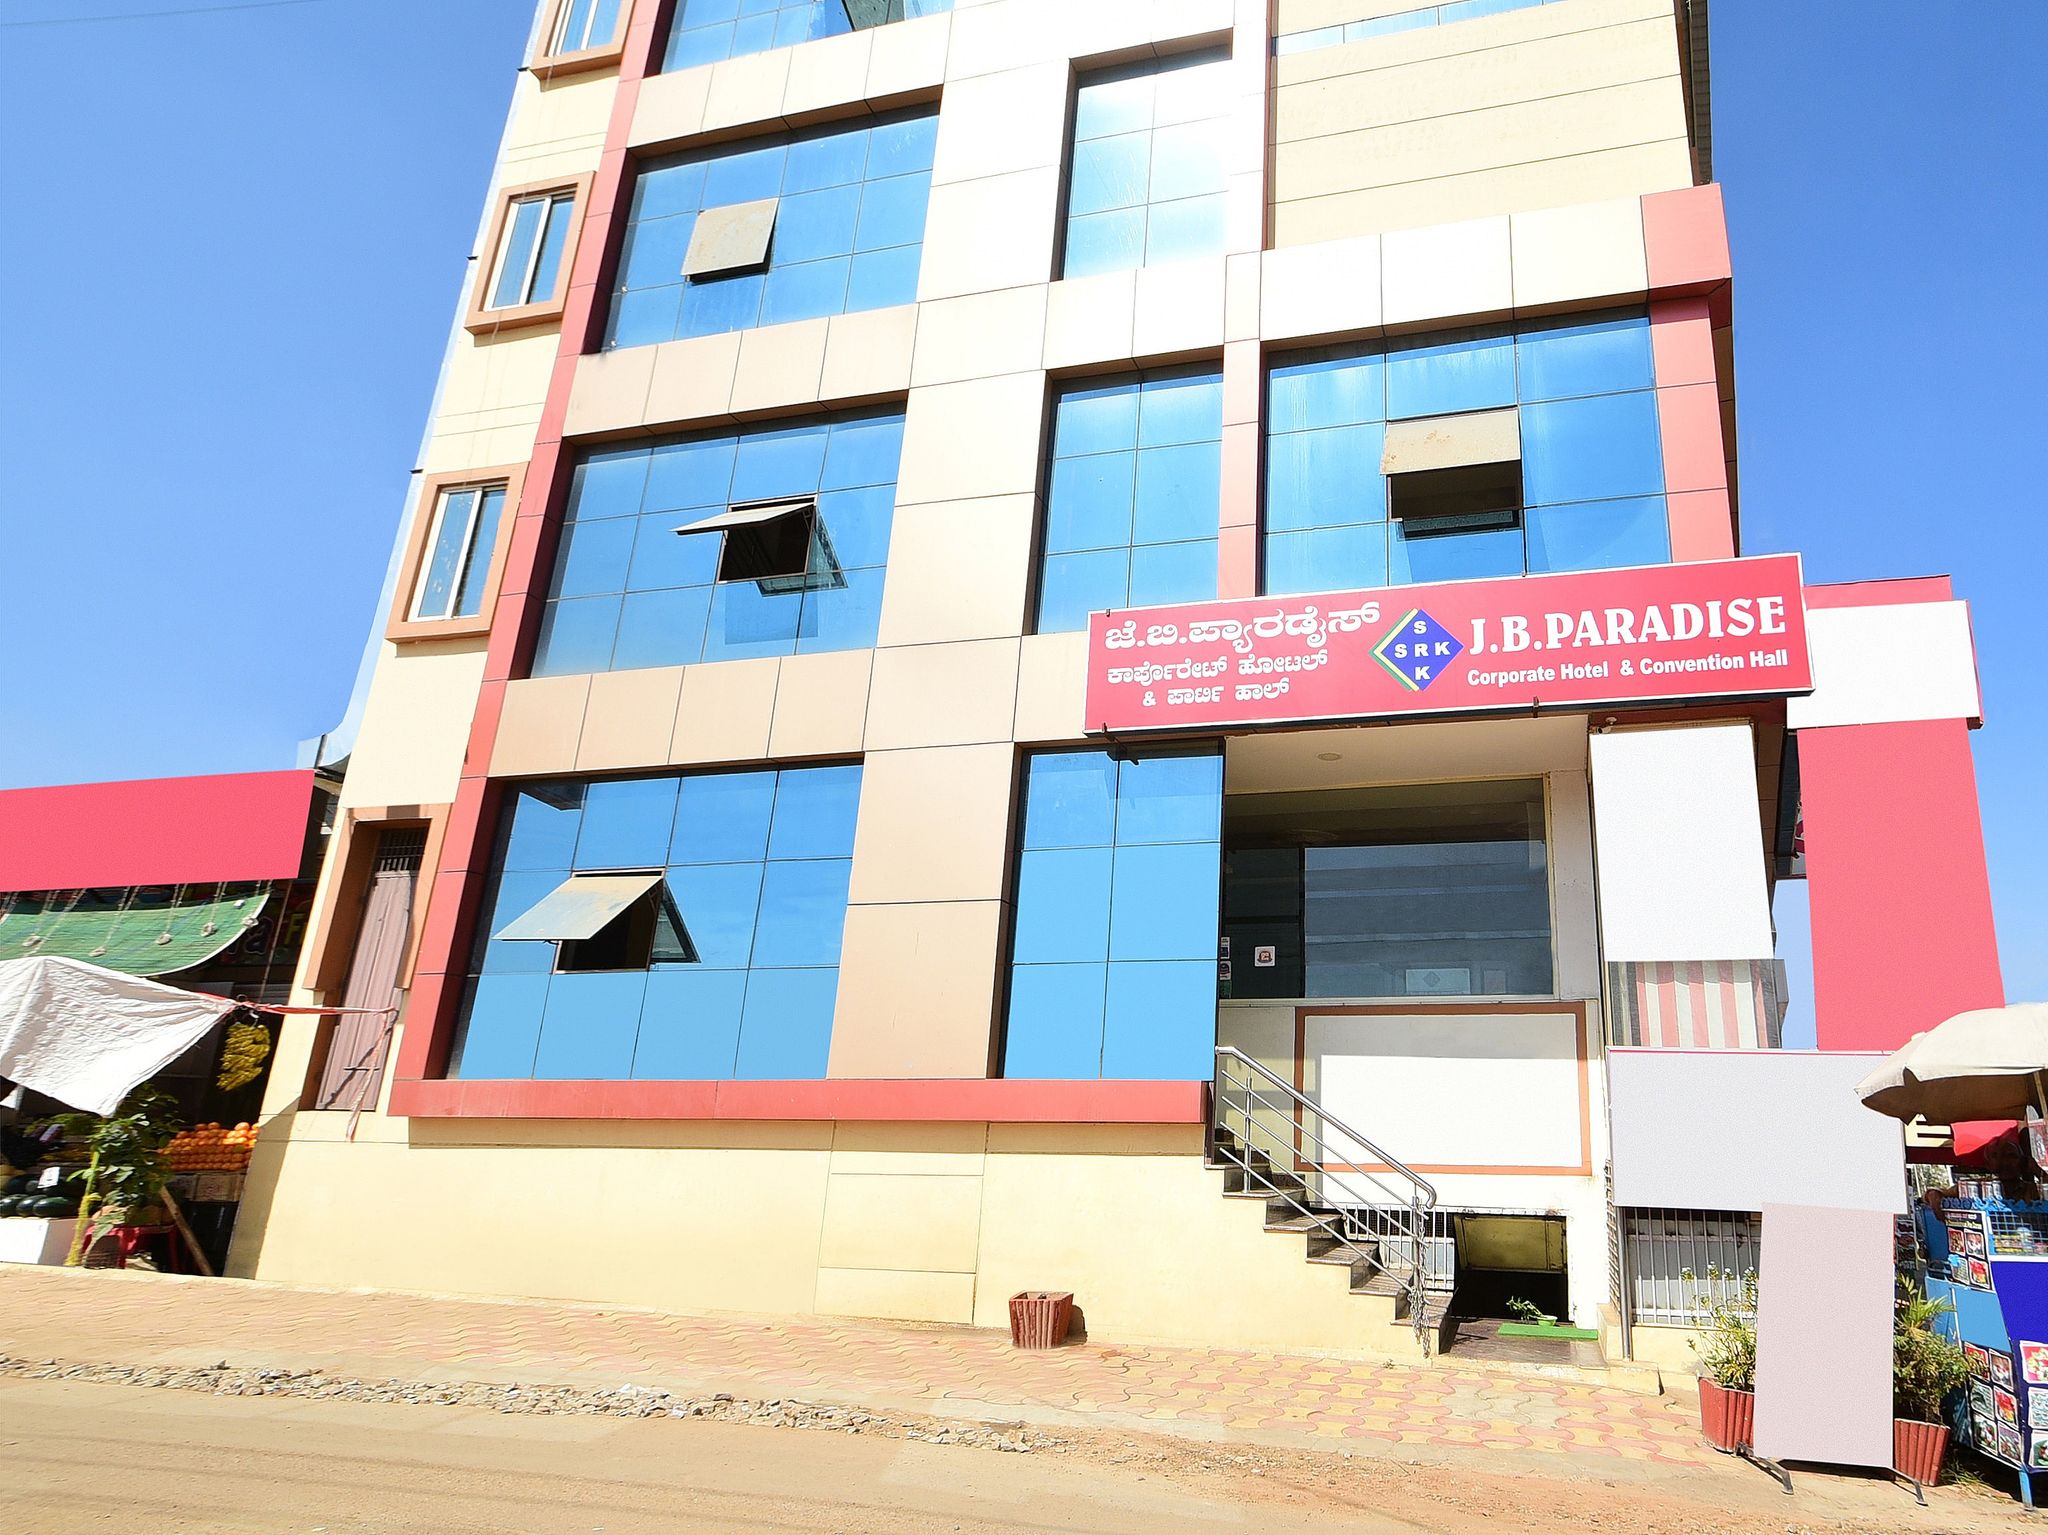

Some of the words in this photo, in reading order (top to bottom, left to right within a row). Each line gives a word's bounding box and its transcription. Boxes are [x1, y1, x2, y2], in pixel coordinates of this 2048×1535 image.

[1469, 596, 1786, 656] J.B.PARADISE
[1467, 665, 1556, 688] Corporate
[1560, 660, 1609, 680] Hotel
[1619, 659, 1635, 676] &
[1639, 652, 1746, 675] Convention
[1749, 649, 1789, 668] Hall
[1142, 690, 1157, 707] &
[1234, 676, 1290, 701] ಹಾಲ್
